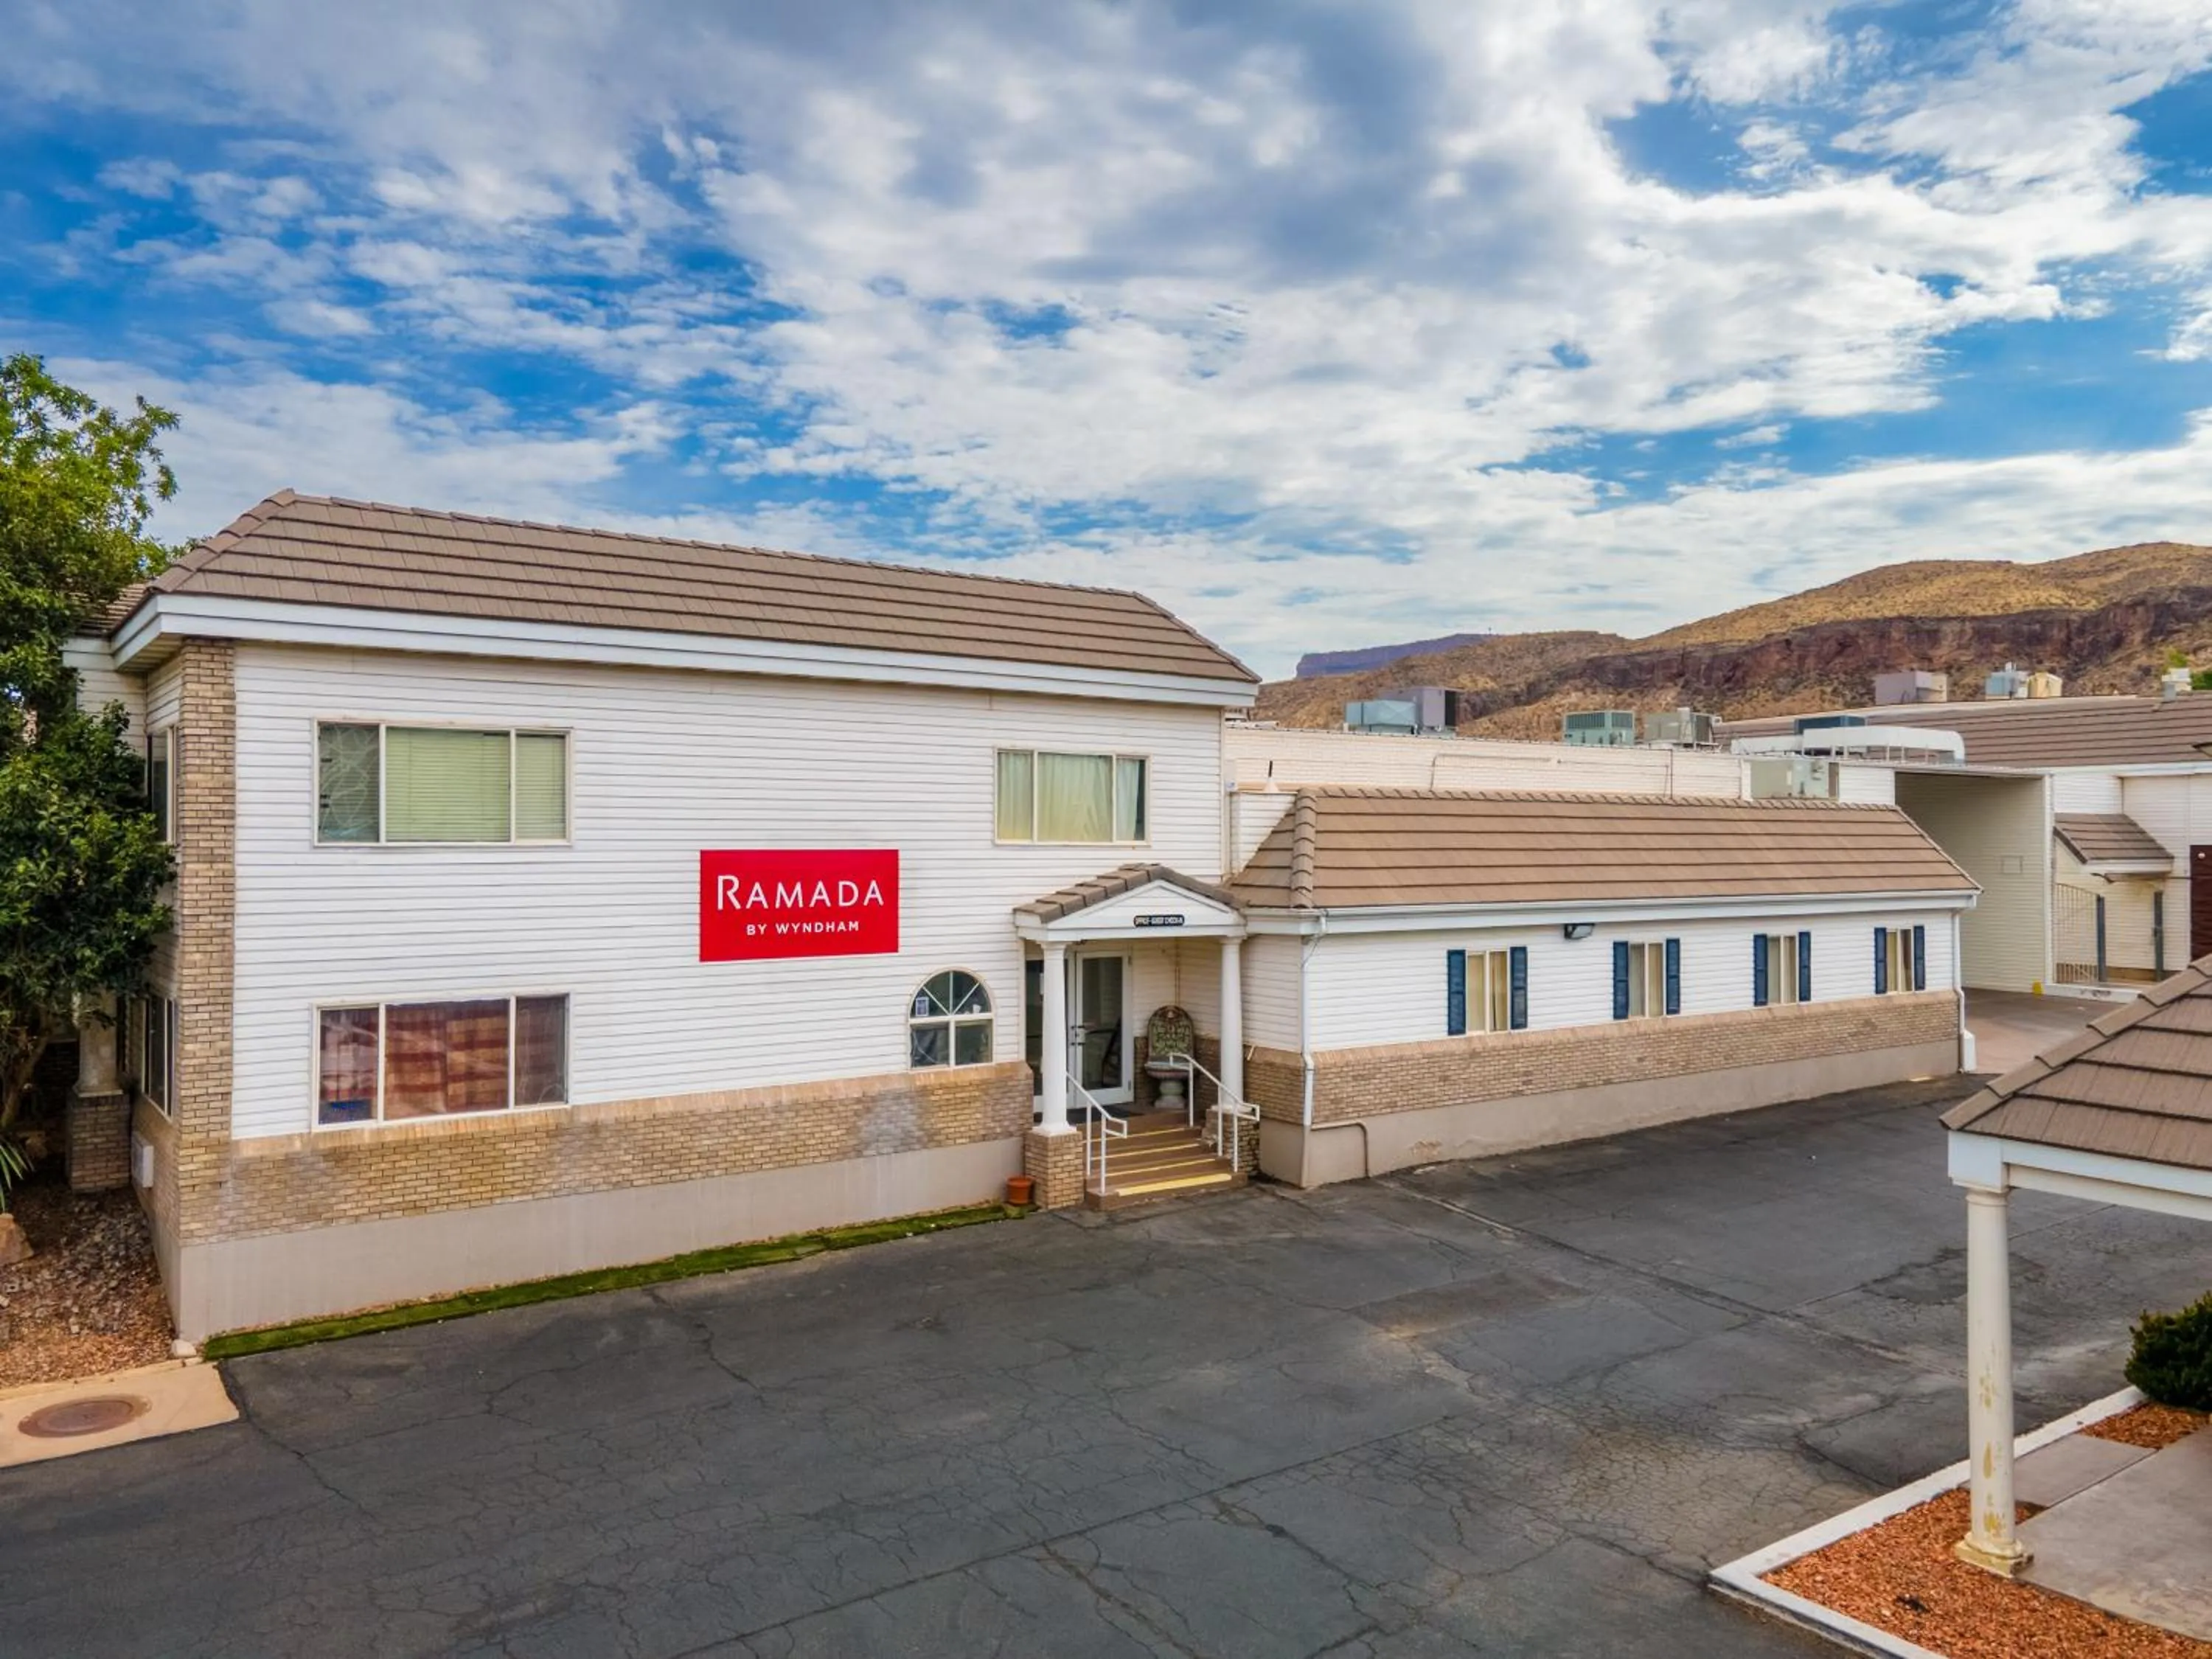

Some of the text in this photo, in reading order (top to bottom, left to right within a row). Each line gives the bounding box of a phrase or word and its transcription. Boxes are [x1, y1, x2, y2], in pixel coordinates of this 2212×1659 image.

[717, 874, 884, 911] RAMADA
[746, 921, 859, 936] BY WYNDHAM
